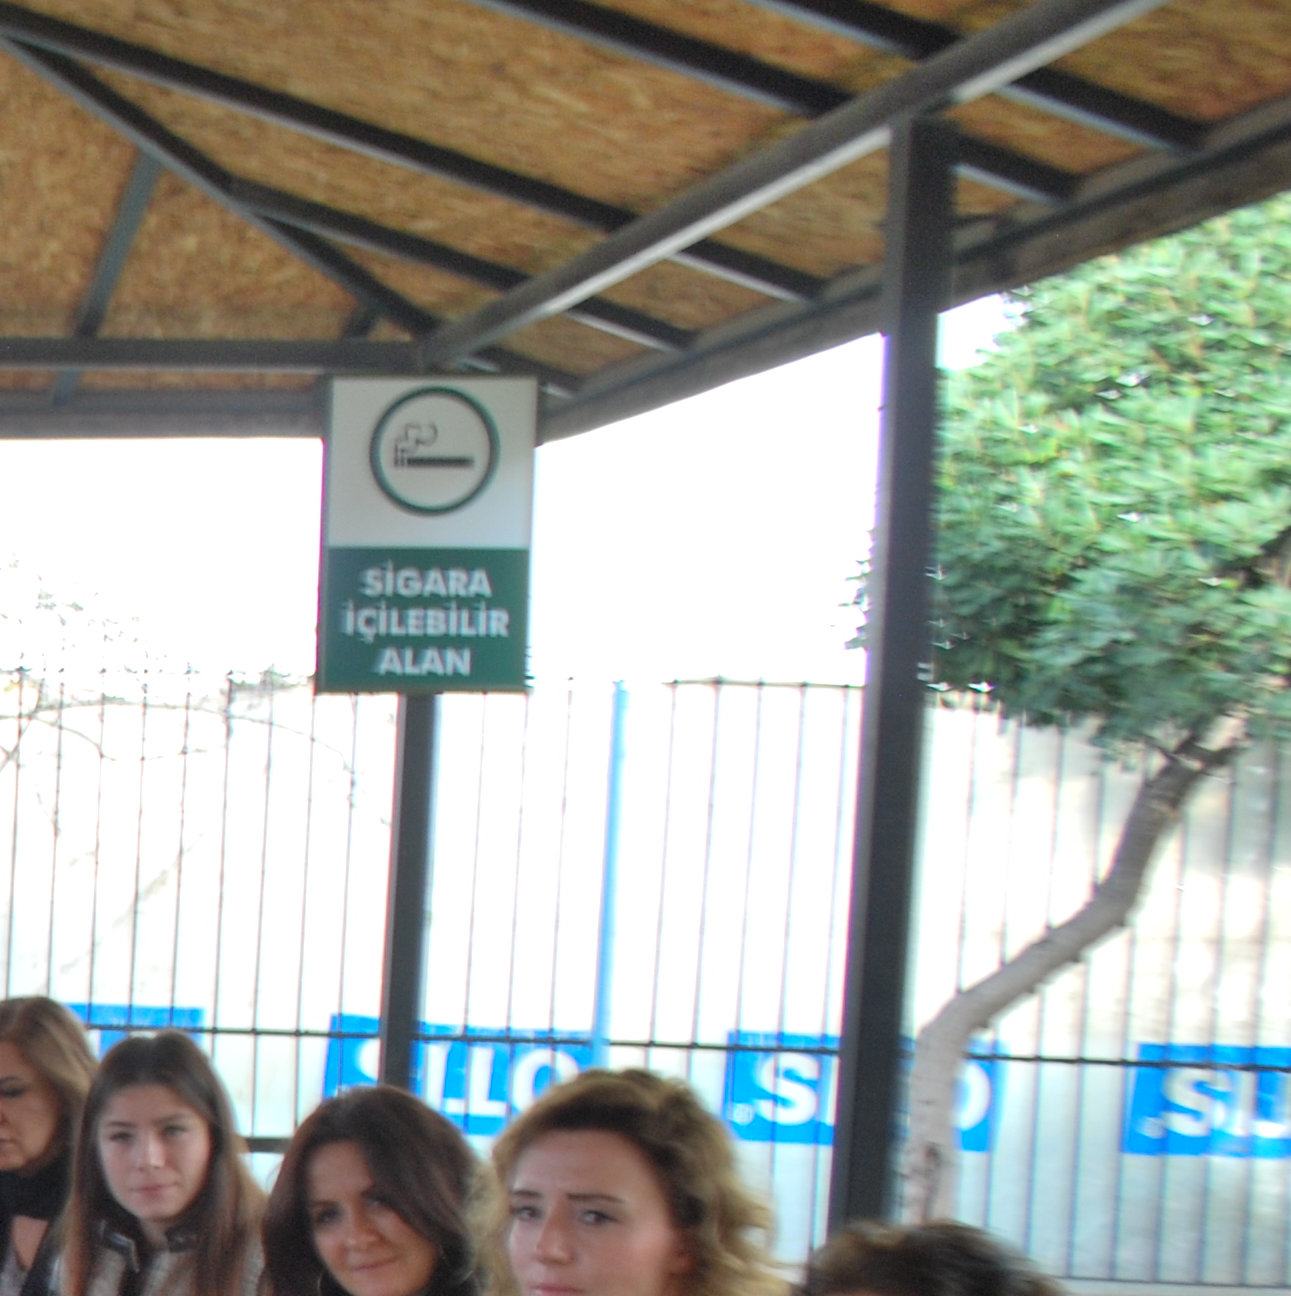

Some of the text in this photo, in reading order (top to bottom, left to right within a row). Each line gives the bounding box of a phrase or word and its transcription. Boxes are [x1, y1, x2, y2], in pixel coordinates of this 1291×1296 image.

[362, 559, 493, 598] SİGARA
[342, 600, 510, 643] İÇİLEBİLİR
[373, 647, 471, 677] ALAN
